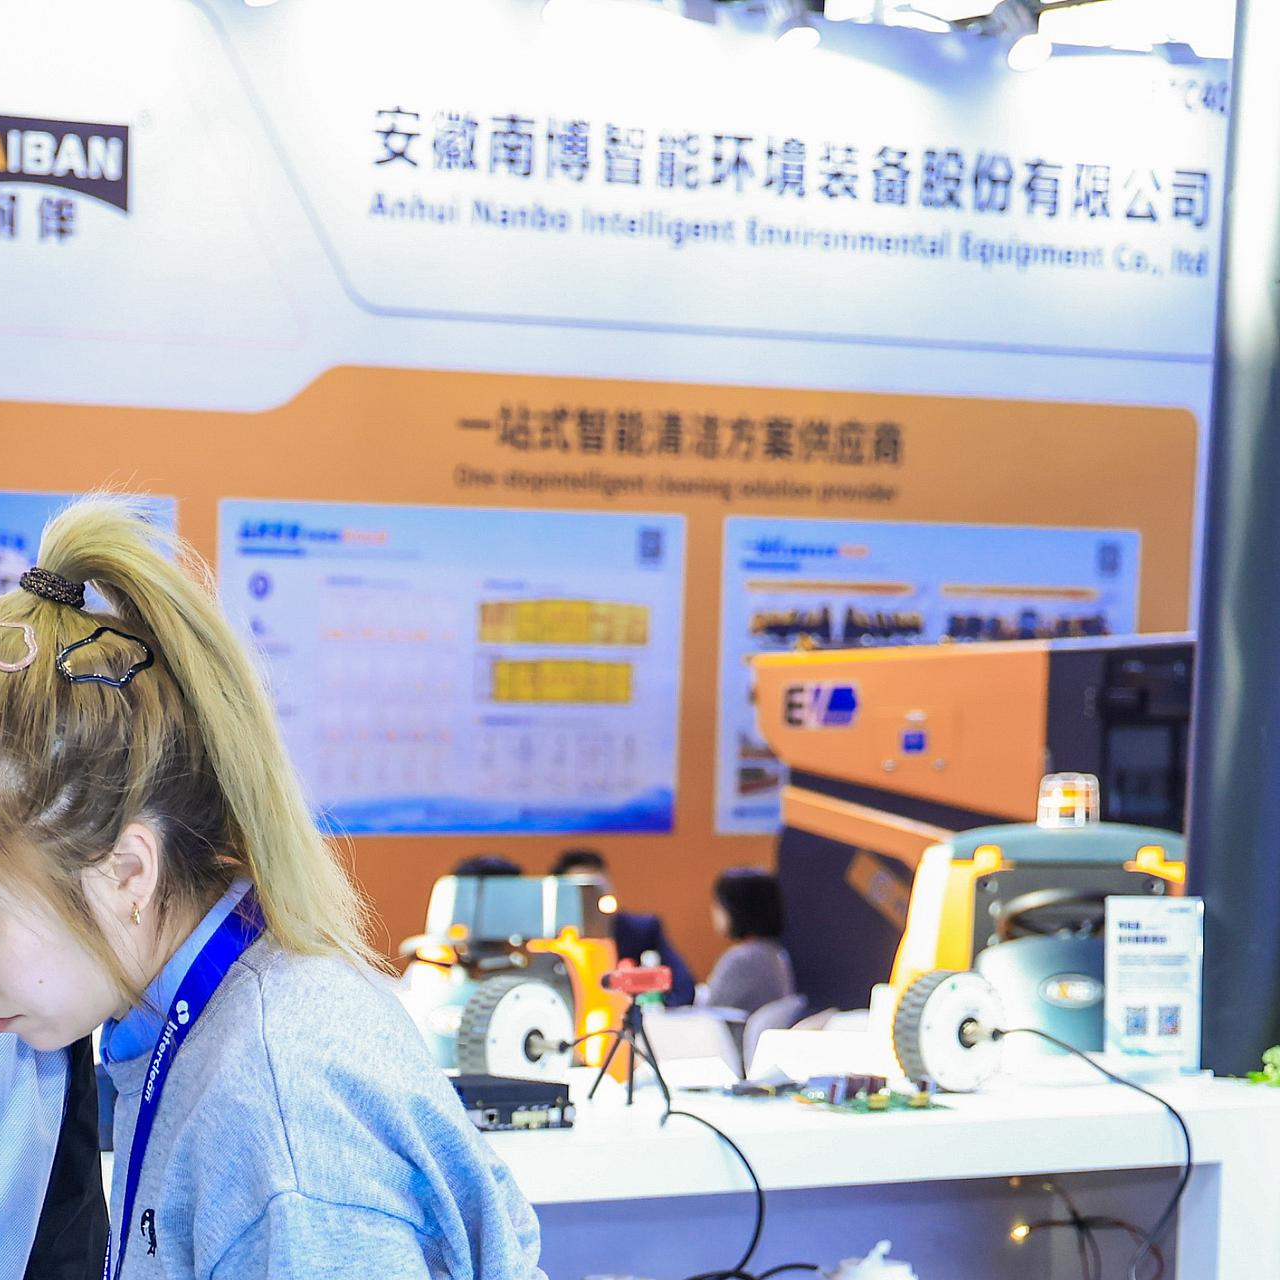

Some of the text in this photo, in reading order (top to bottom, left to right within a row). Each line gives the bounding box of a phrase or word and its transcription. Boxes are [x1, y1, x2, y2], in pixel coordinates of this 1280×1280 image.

[374, 104, 1209, 229] 安徽南博智能环境装备股份有限公司
[370, 193, 458, 223] Anhui
[473, 199, 570, 231] Nanbo
[582, 206, 735, 249] Intelligent
[746, 217, 951, 259] Environmental
[960, 230, 1105, 267] Equipment
[144, 1020, 179, 1102] Interclean
